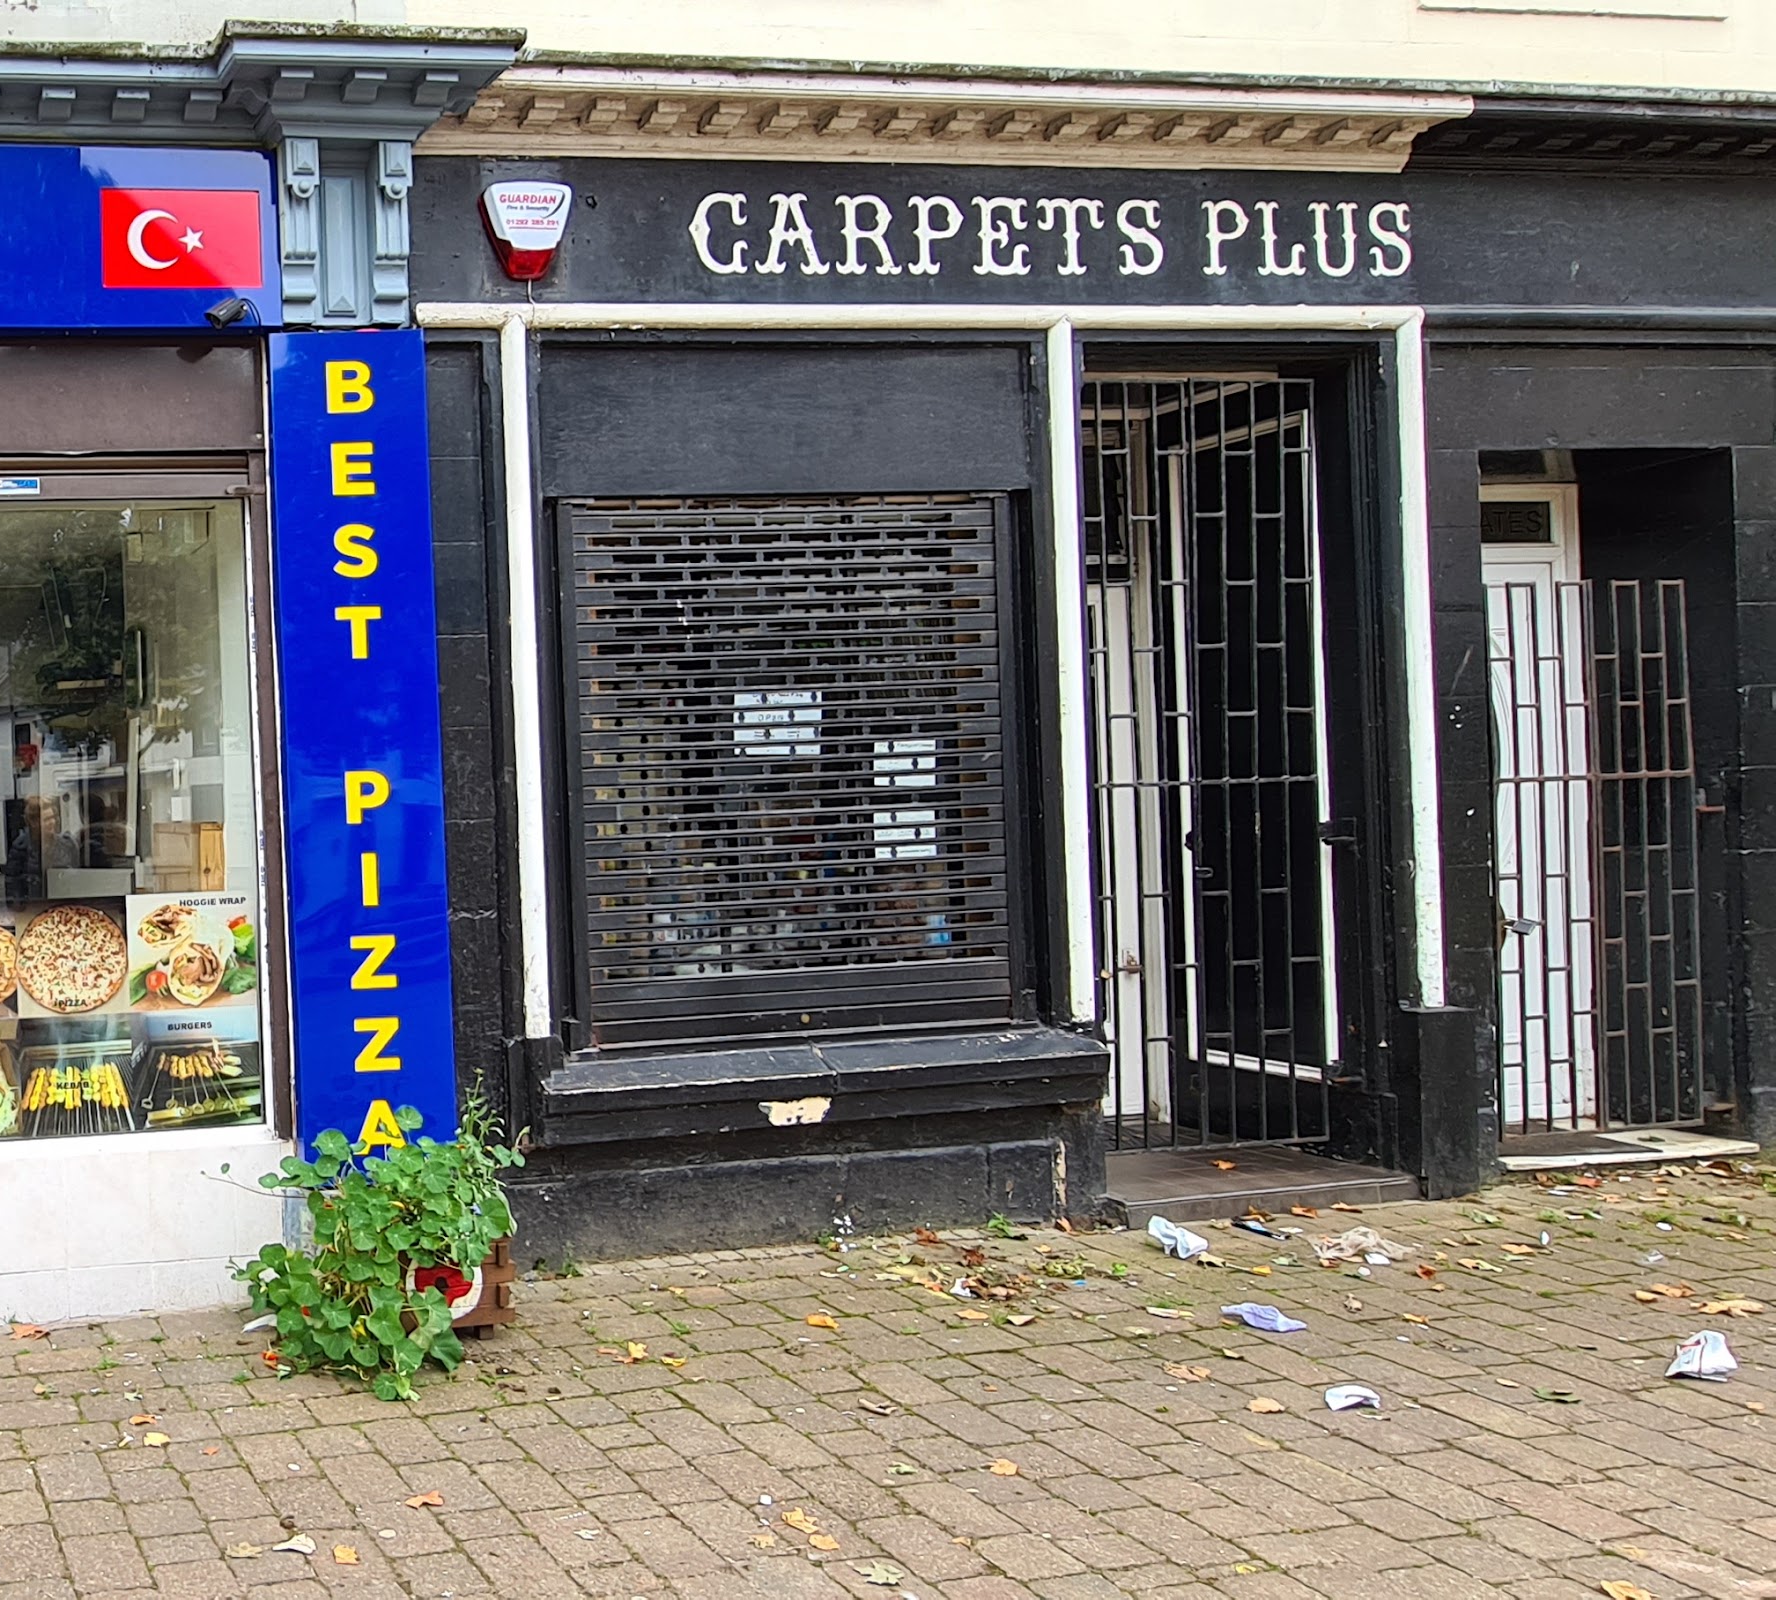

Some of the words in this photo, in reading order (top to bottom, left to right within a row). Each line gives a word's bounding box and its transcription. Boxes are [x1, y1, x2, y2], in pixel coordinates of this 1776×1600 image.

[499, 194, 557, 204] GUARDIAN
[687, 192, 1165, 278] CARPETS
[1200, 199, 1414, 279] PLUS
[326, 359, 382, 660] BEST
[219, 897, 246, 905] WRAP
[346, 769, 408, 1156] PIZZA
[167, 1022, 213, 1031] BURGERS
